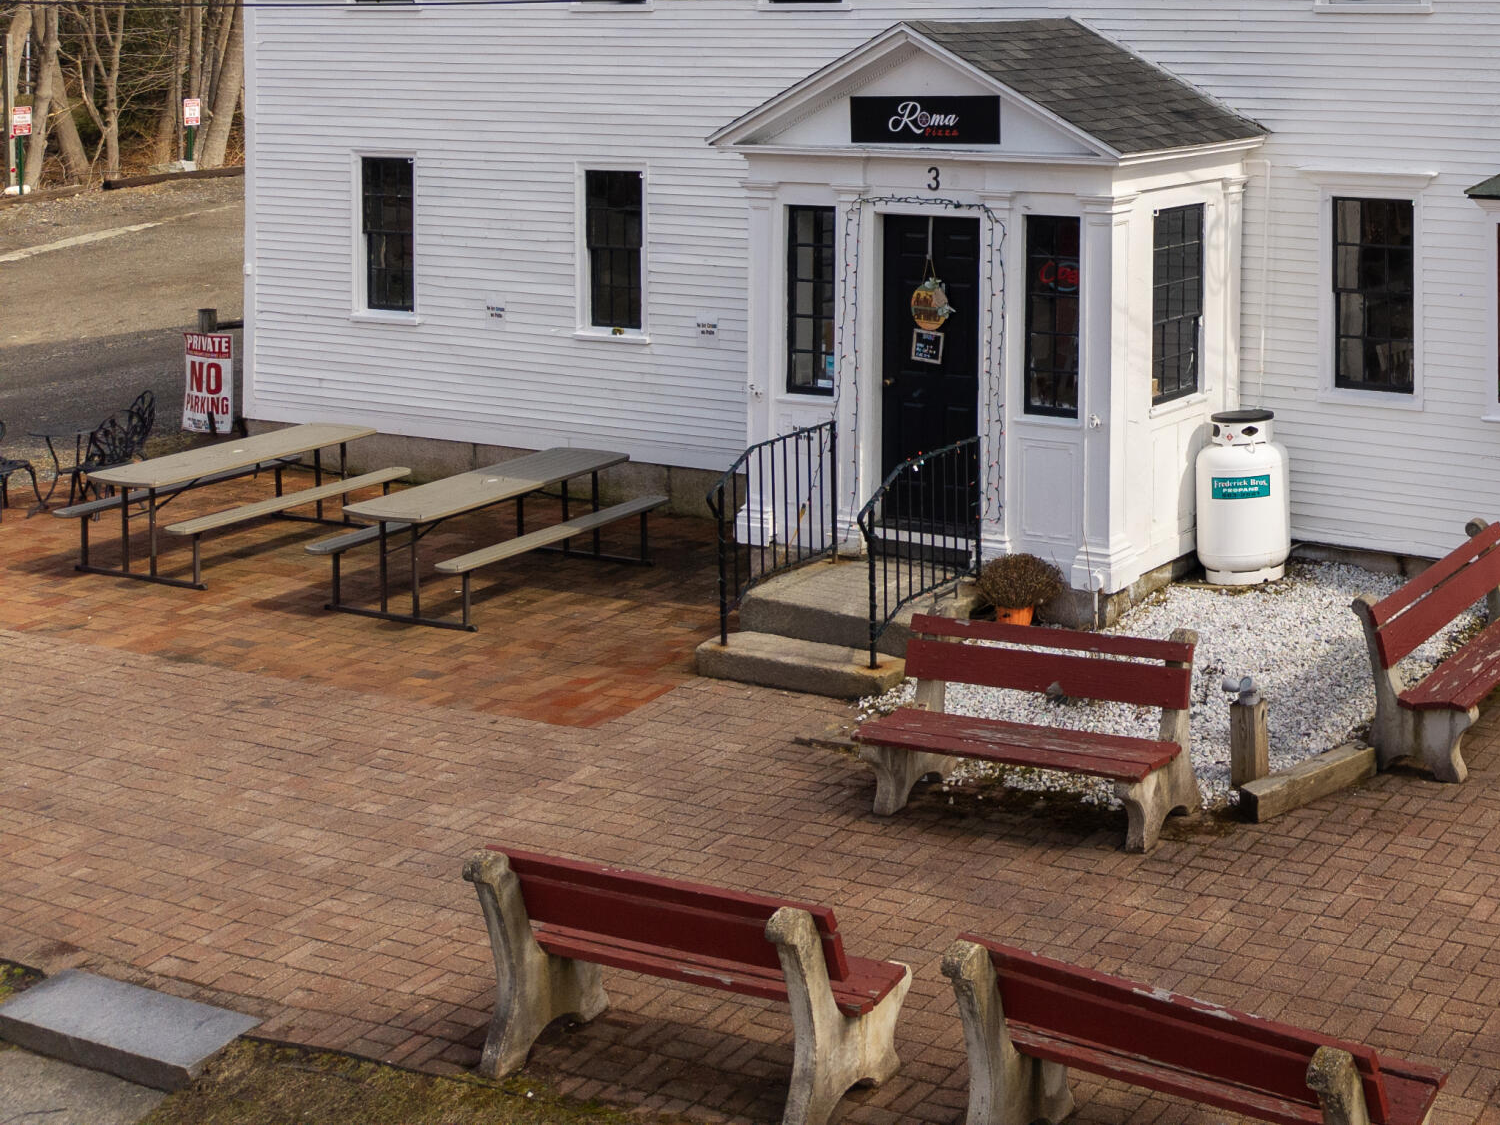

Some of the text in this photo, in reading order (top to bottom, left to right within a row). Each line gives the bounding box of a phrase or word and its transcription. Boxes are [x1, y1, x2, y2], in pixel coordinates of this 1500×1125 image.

[888, 101, 959, 134] Roma
[924, 127, 959, 137] Pizza
[927, 166, 940, 191] 3
[186, 334, 230, 353] PRIVATE
[190, 360, 222, 395] NO
[185, 393, 229, 415] PARKING
